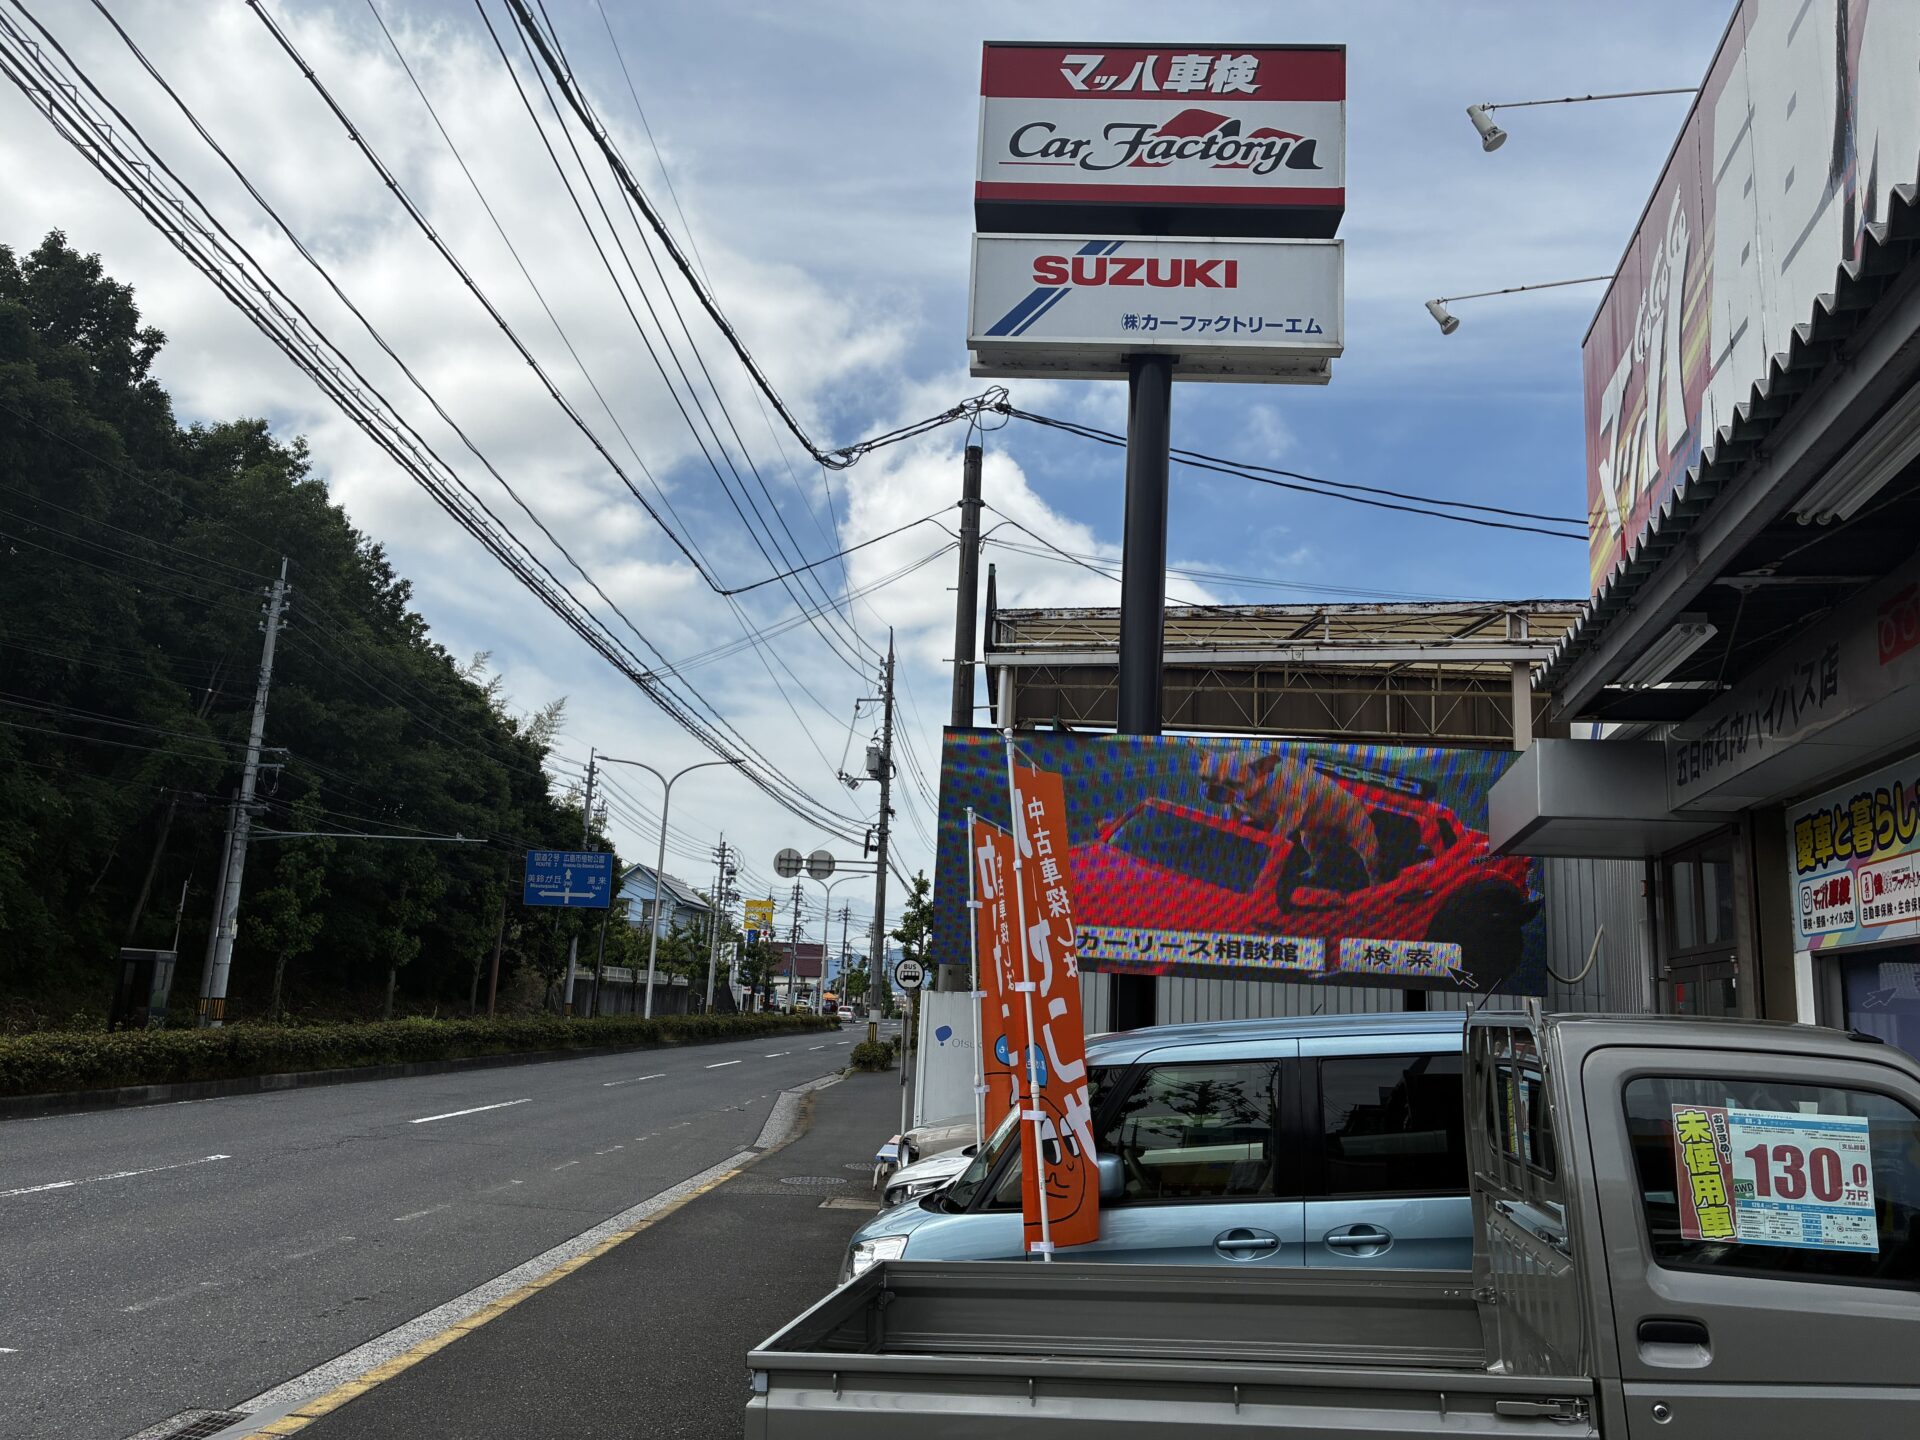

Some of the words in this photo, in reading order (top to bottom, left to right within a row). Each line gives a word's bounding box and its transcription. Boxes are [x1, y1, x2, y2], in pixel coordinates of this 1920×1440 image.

[1060, 53, 1263, 94] マッハ車検
[1008, 121, 1091, 160] Car
[1079, 122, 1292, 175] Factory
[1032, 254, 1239, 289] SUZUKI
[1794, 778, 1920, 876] 愛車と暮らし
[1077, 930, 1299, 965] カーリース相談館
[1674, 1109, 1736, 1239] 未使用車
[1734, 1182, 1754, 1194] 4WD
[1844, 1189, 1869, 1202] 万円
